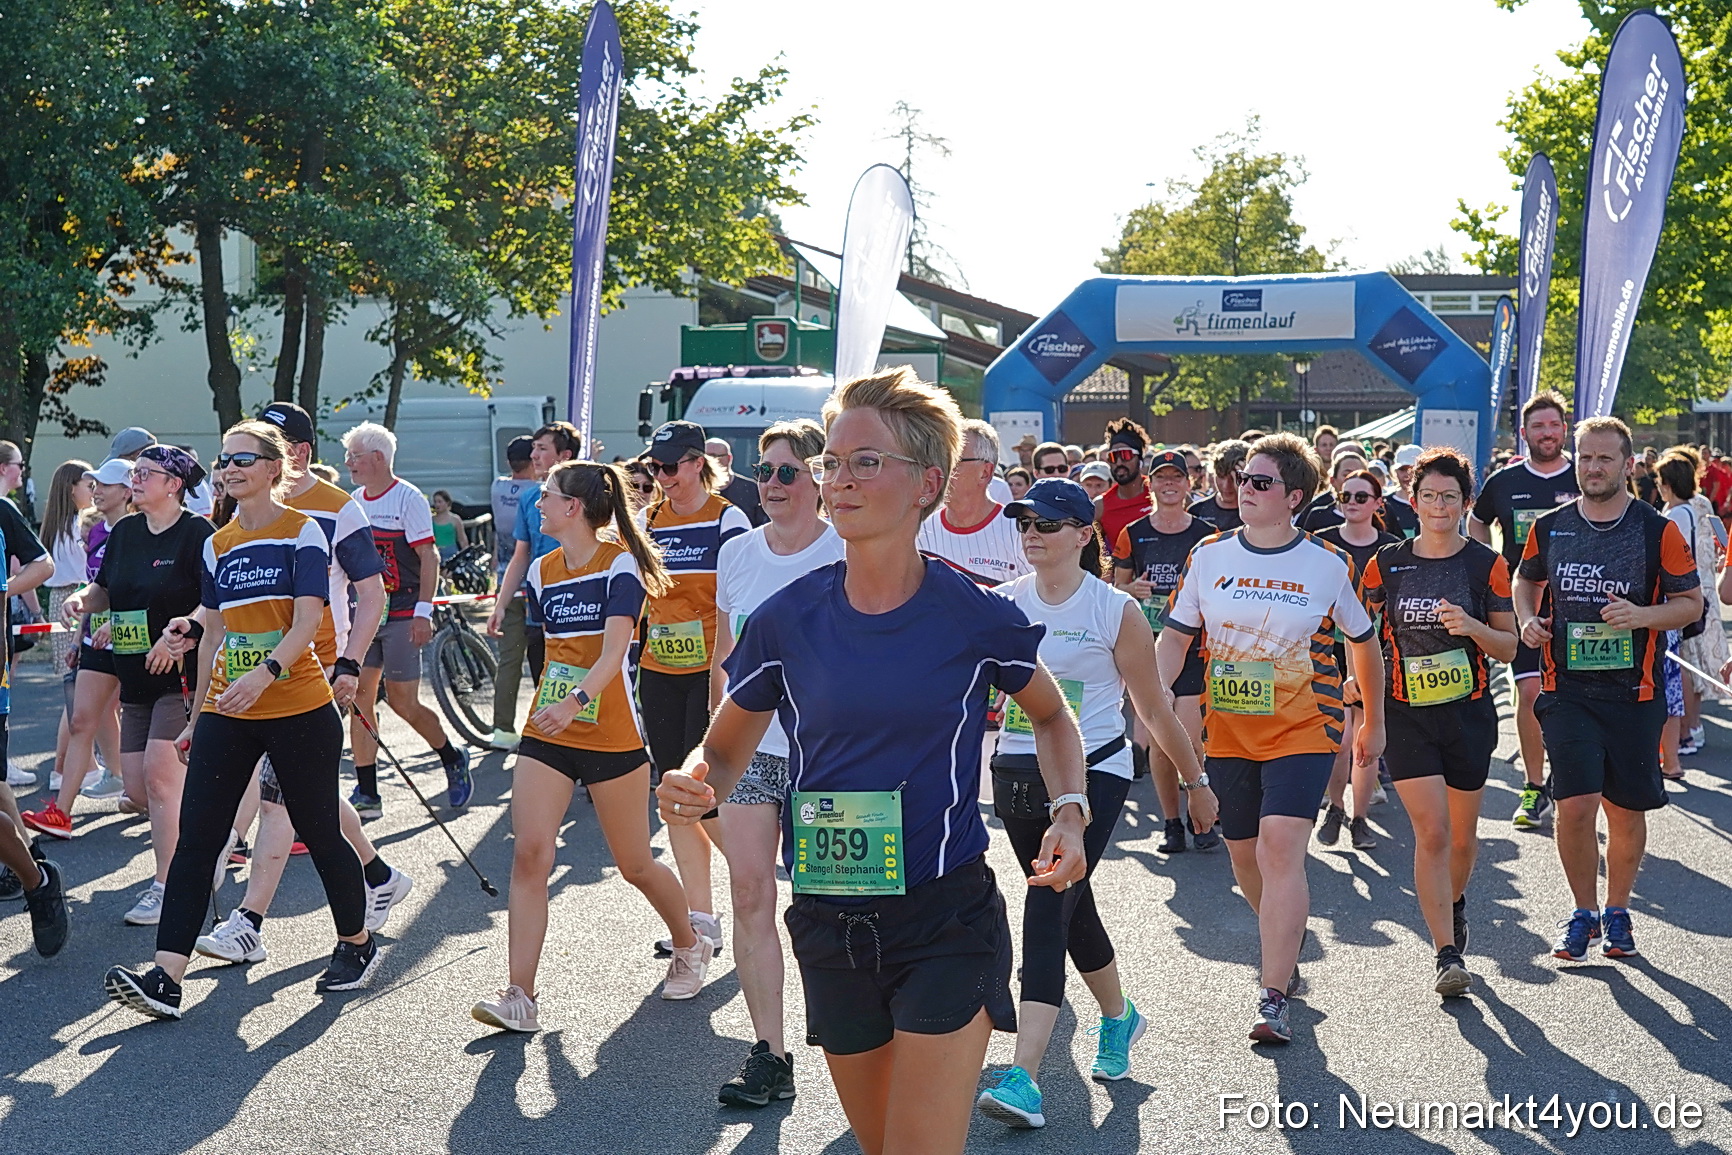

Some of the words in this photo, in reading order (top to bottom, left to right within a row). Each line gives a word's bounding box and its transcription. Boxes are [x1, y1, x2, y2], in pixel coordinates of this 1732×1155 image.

[1616, 53, 1662, 197] Fischer
[1634, 77, 1670, 192] AUTOMOBILE
[1207, 311, 1297, 329] firmenlauf
[1037, 341, 1086, 353] Fischer
[1594, 279, 1635, 418] her-automobile.de
[969, 557, 1008, 569] NEUMARKT
[1146, 563, 1179, 575] HECK
[1556, 562, 1606, 579] HECK
[228, 565, 283, 584] Fischer
[1150, 573, 1181, 583] DESI
[233, 579, 277, 590] AUTOMOBILE
[1237, 578, 1310, 595] KLEBL
[1560, 577, 1631, 595] DESIGN
[1232, 590, 1309, 606] DYNAMICS
[1398, 598, 1441, 610] HECK
[556, 614, 600, 624] AUTOMOBILE
[1403, 611, 1443, 623] DESI
[113, 626, 139, 640] 1941
[657, 638, 695, 653] 1830
[1578, 639, 1620, 655] 1741
[1416, 667, 1462, 690] 1990
[1462, 667, 1471, 690] 2022
[540, 681, 549, 705] WALK
[1219, 679, 1263, 697] 1049
[1409, 676, 1418, 700] WALK
[1241, 698, 1265, 706] Sandra
[1008, 704, 1016, 724] WAL
[816, 810, 845, 819] Firmenlauf
[815, 828, 869, 861] 959
[798, 838, 807, 872] RUN
[884, 833, 897, 880] 2022
[806, 864, 833, 875] Stengel
[835, 864, 885, 876] Stephanie
